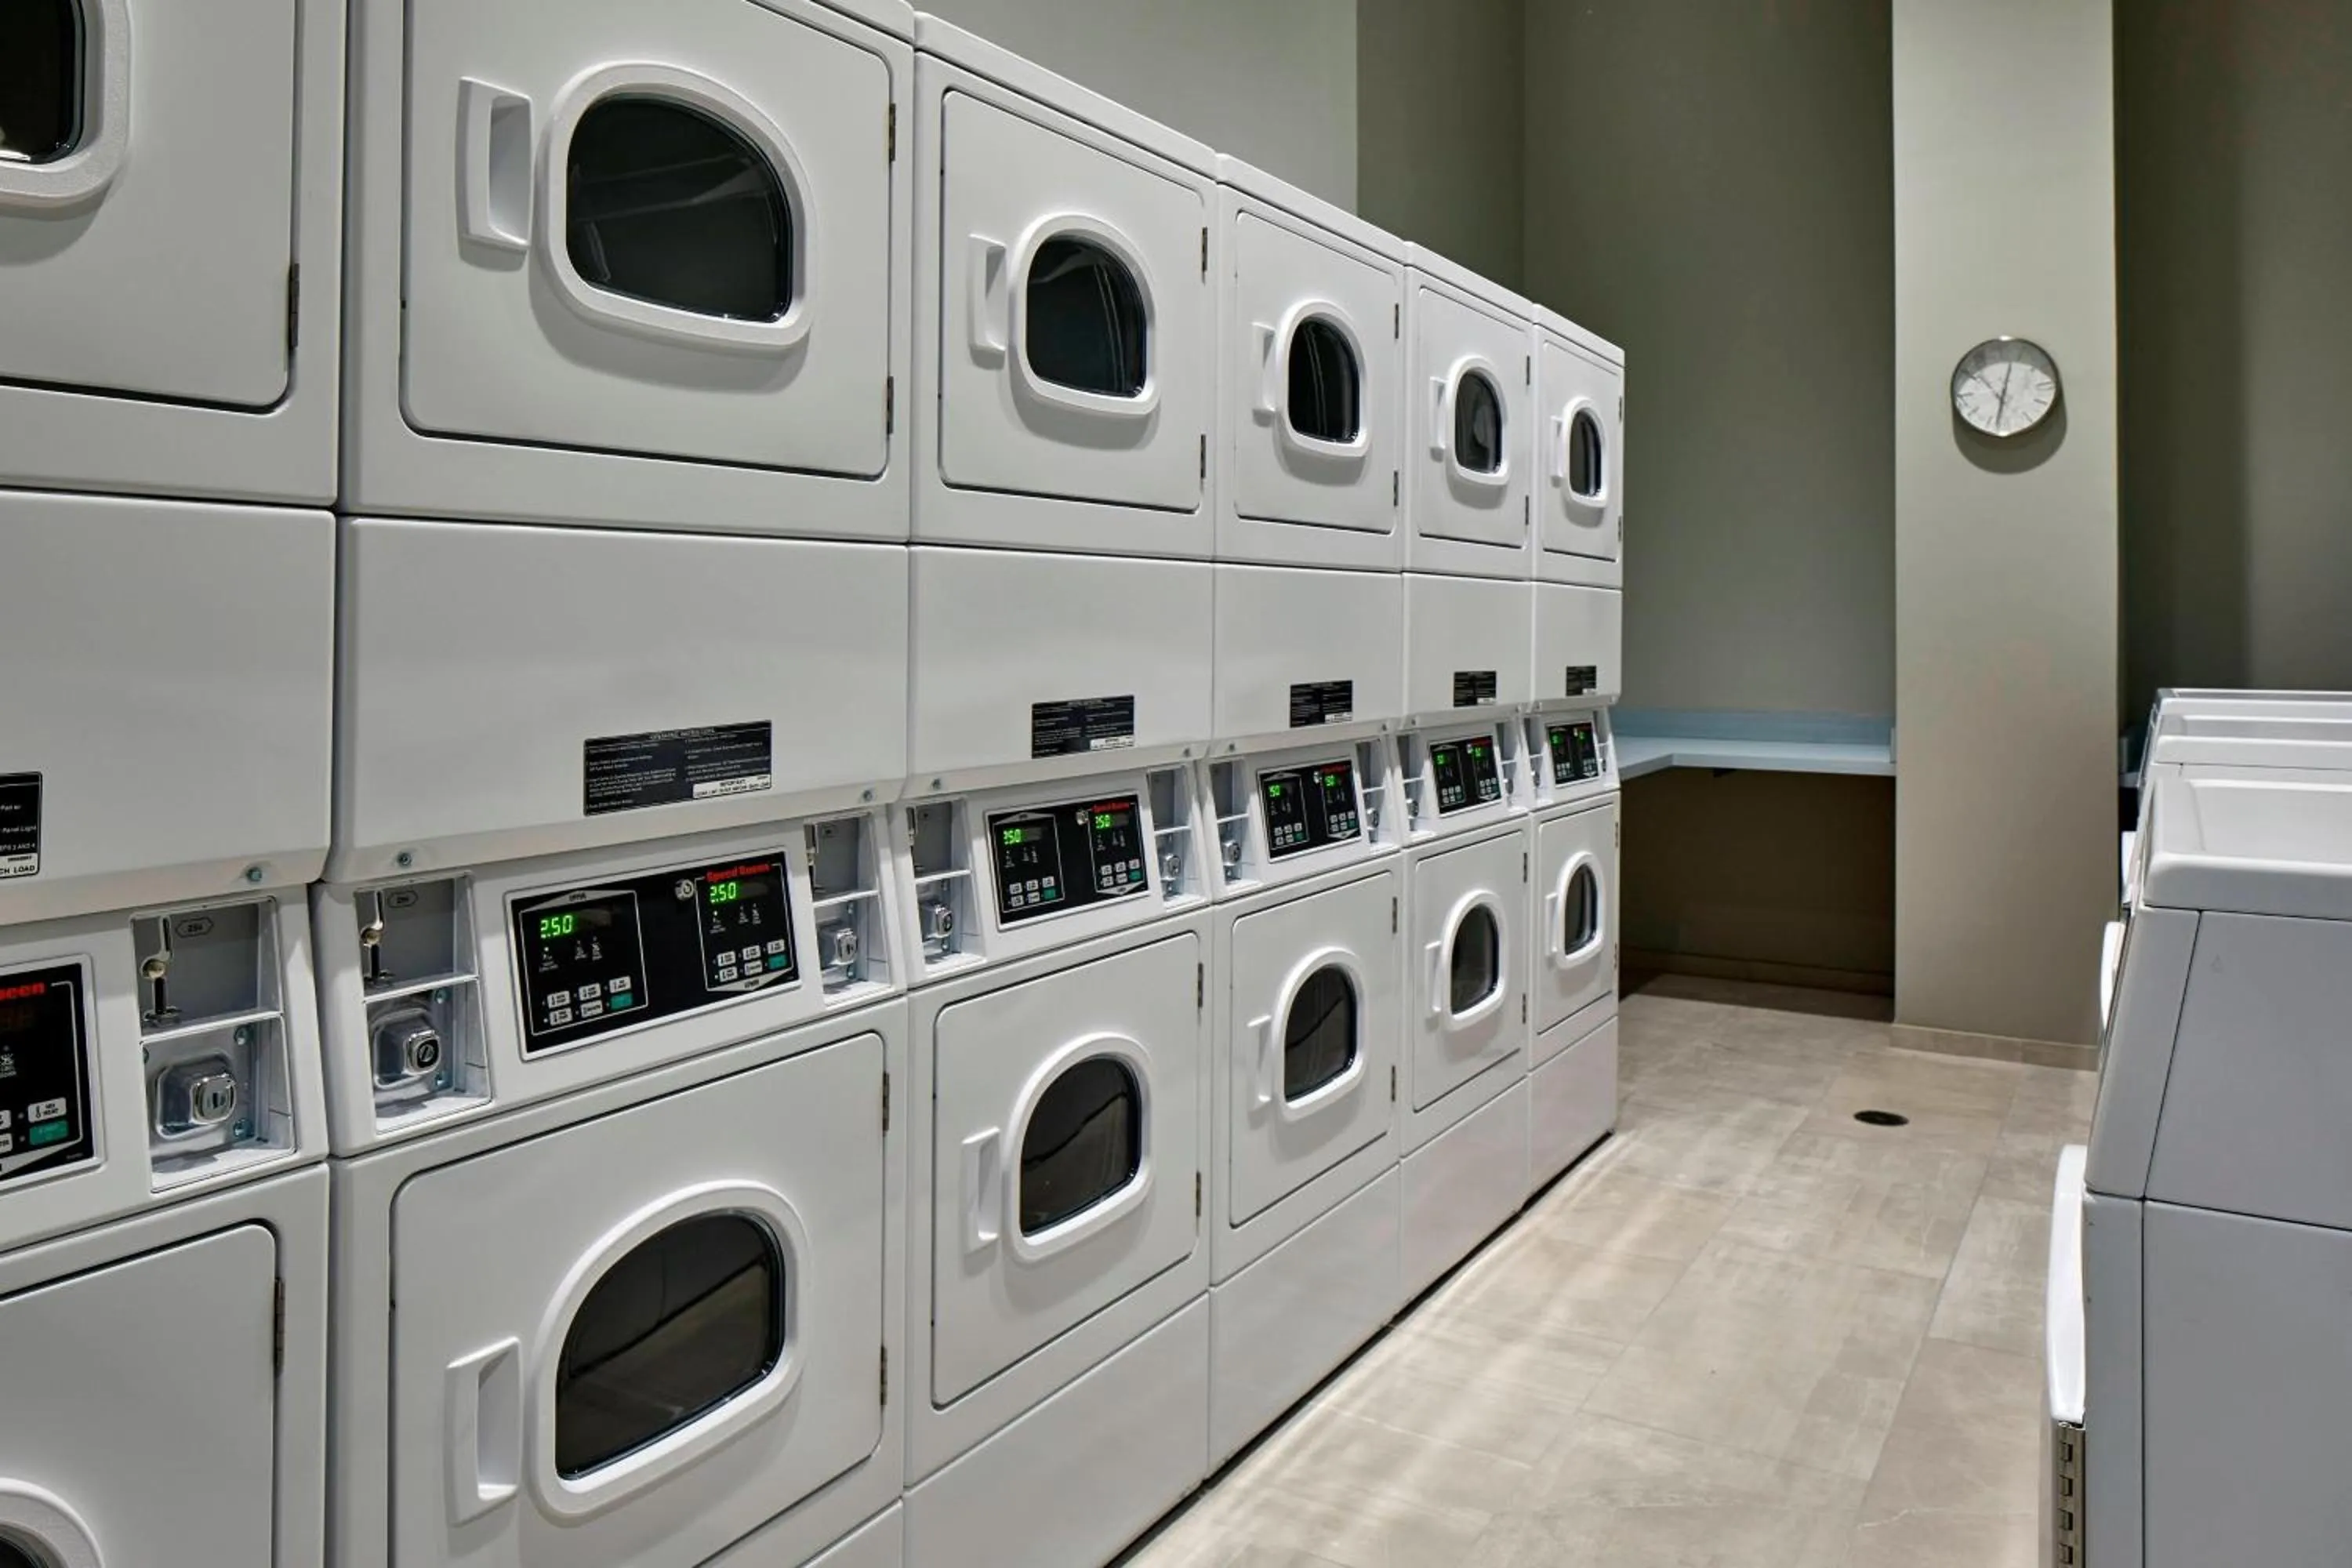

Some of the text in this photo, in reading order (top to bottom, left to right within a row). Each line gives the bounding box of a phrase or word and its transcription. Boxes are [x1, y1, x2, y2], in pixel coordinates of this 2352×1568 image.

[13, 864, 35, 873] LOAD
[710, 881, 737, 904] 2.50
[540, 914, 573, 939] 2.50
